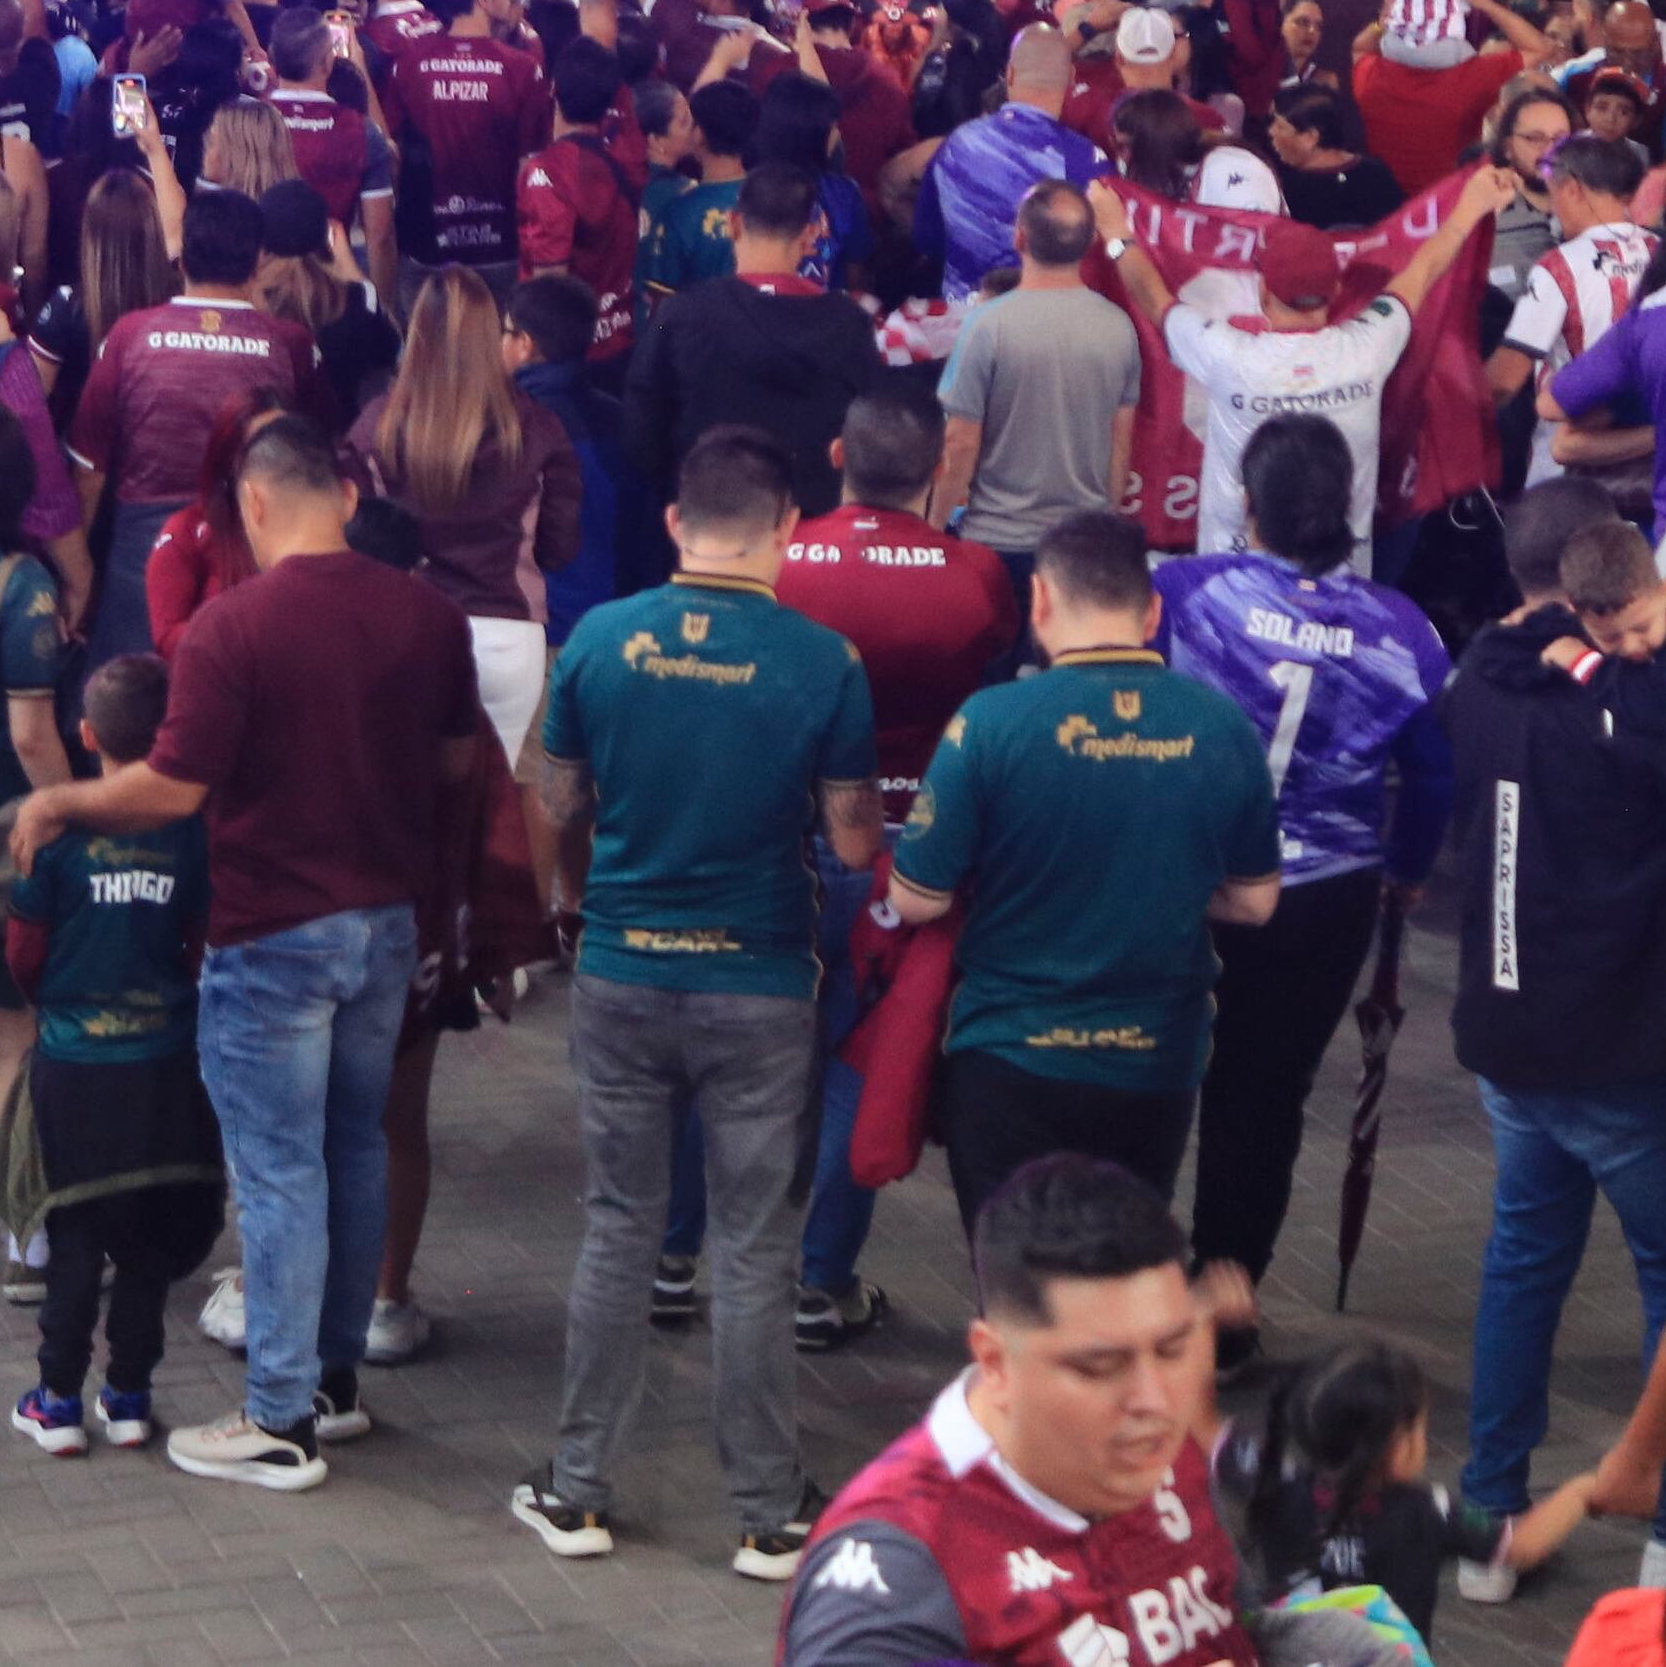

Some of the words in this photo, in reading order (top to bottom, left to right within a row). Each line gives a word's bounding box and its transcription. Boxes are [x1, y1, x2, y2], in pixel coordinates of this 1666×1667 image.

[430, 58, 503, 75] GATORADE
[433, 79, 490, 102] ALPIZAR
[164, 331, 271, 357] GATORADE
[1251, 382, 1374, 413] GATORADE
[1246, 606, 1355, 658] SOLANO
[1083, 733, 1195, 762] medismart
[1499, 792, 1514, 979] SAPRISSA
